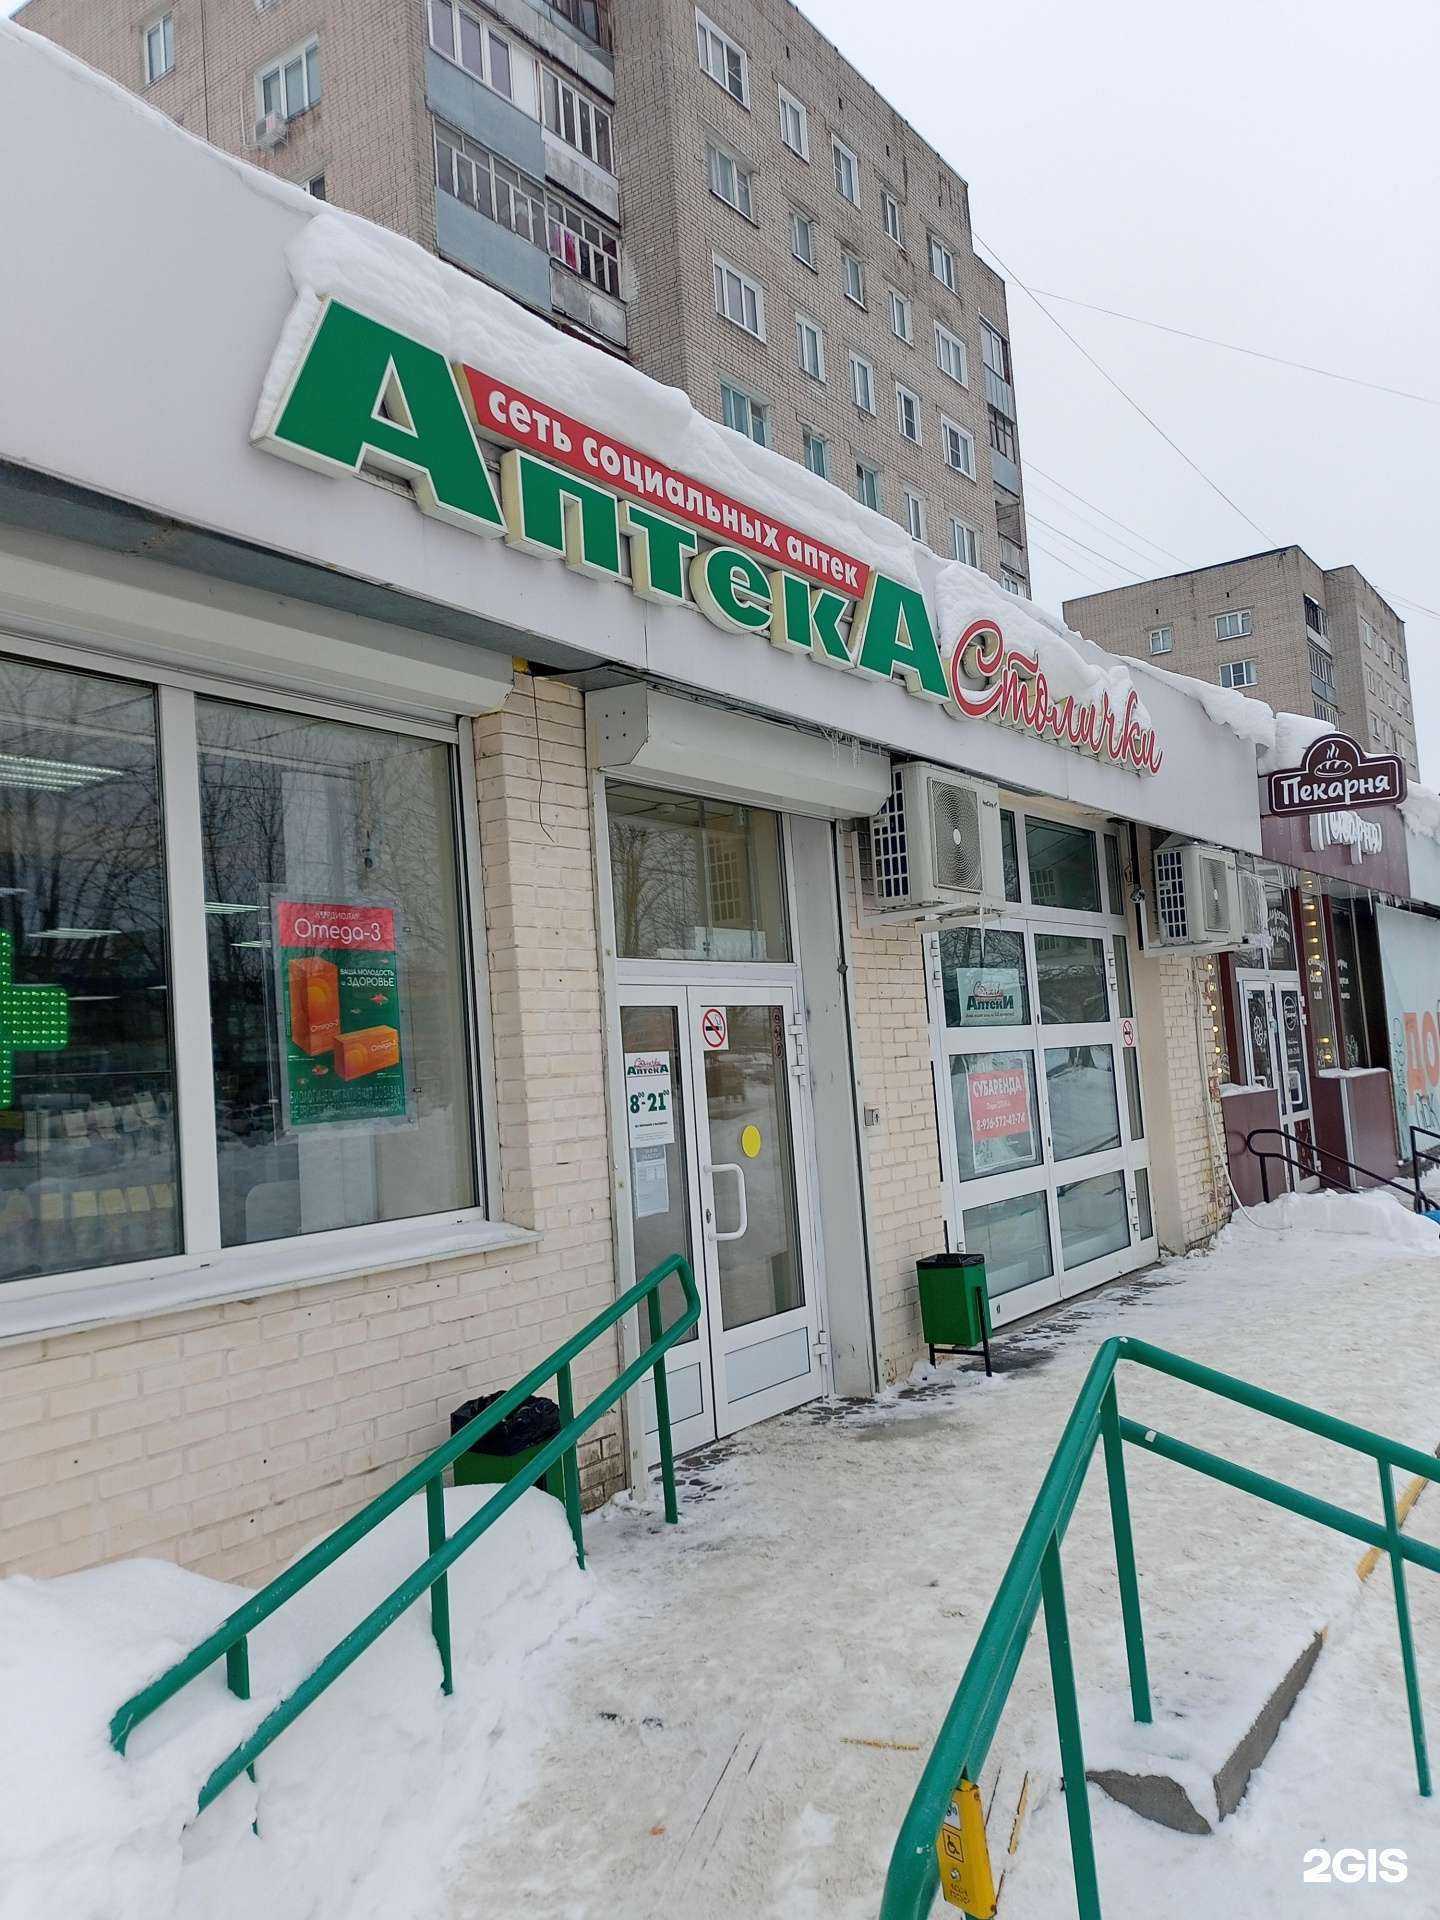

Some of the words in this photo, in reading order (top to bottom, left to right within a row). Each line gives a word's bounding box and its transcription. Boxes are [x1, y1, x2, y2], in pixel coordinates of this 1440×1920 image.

[266, 297, 951, 703] АптекА
[488, 389, 573, 453] сеть
[582, 436, 781, 553] социальных
[786, 535, 859, 589] аптек
[950, 618, 1164, 775] Столички
[1280, 774, 1391, 805] Пекарня
[294, 917, 382, 945] Omega-3
[347, 976, 395, 988] ЗДОРОВЬЕ
[357, 968, 395, 977] МОЛОДОСТЬ
[1402, 1011, 1440, 1105] ДО
